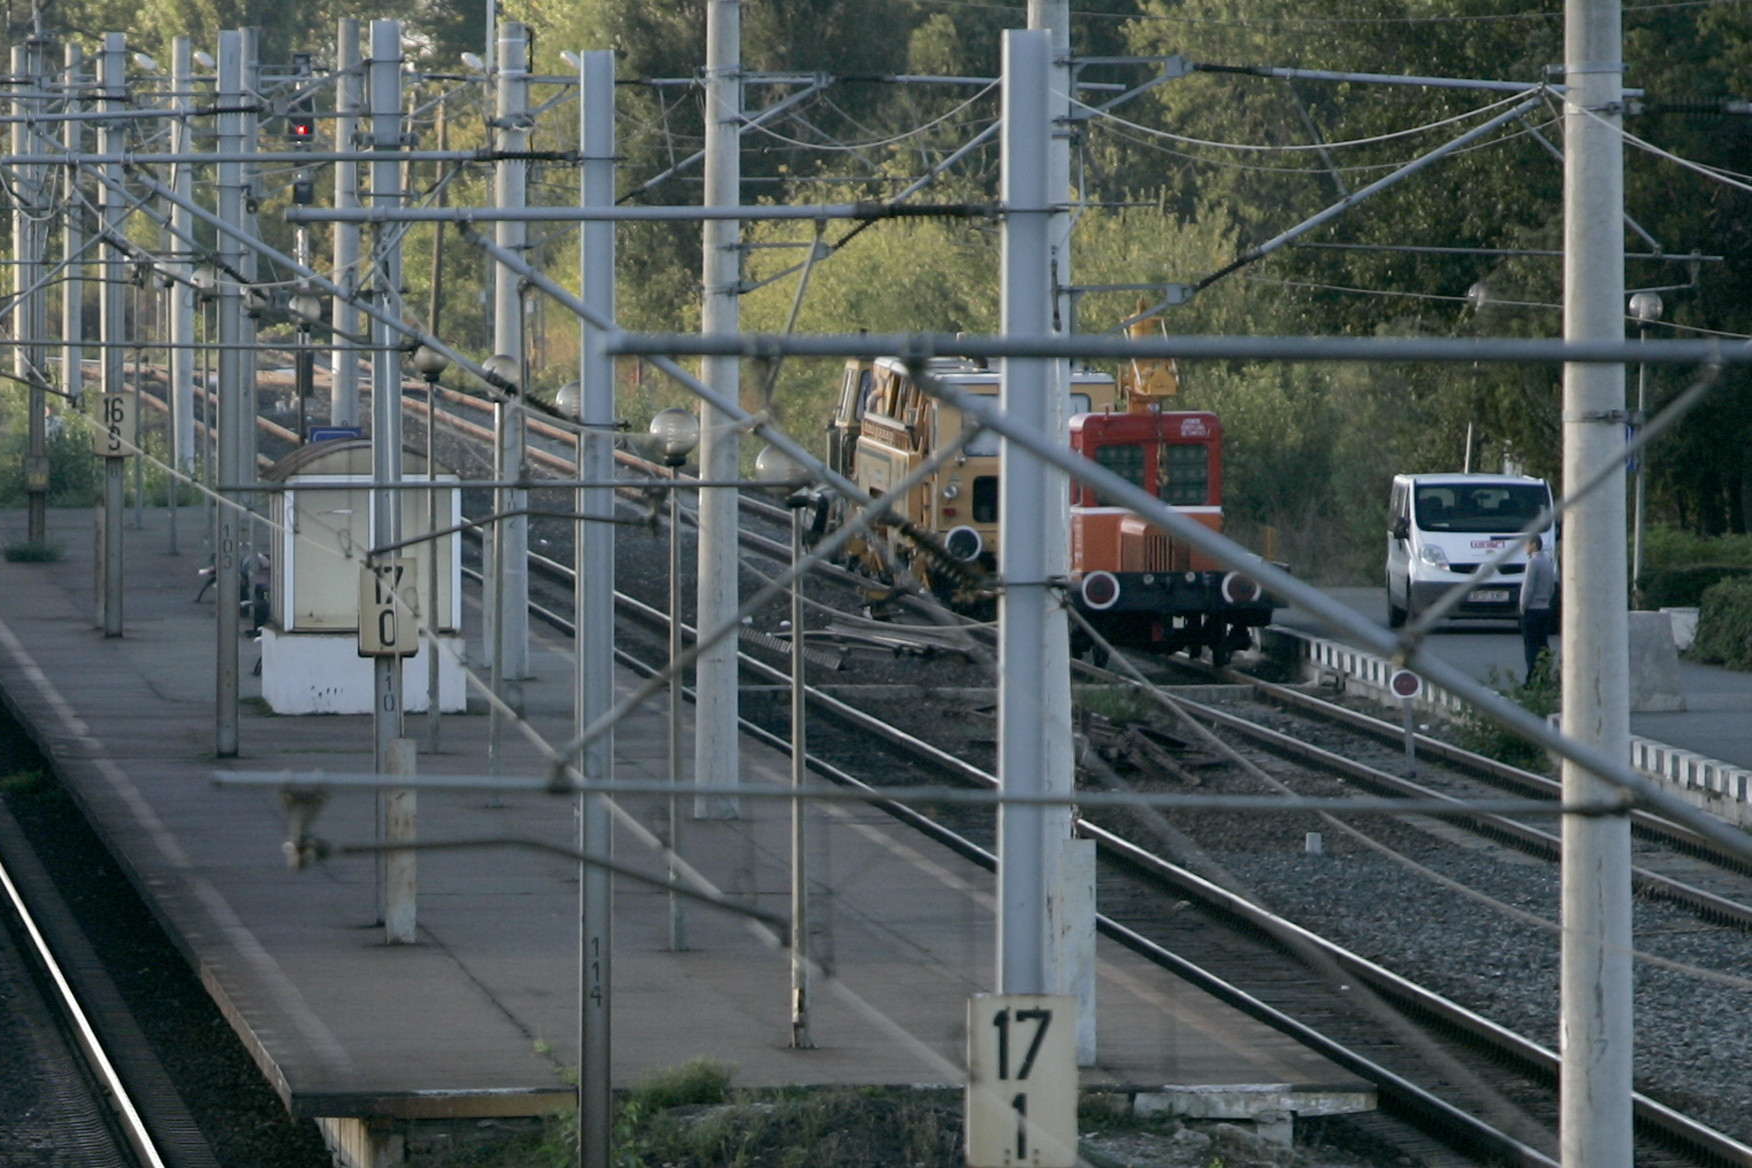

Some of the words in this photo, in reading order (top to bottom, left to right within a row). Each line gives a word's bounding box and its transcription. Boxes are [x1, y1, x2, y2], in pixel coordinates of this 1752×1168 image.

[103, 397, 124, 423] 16
[223, 524, 233, 569] 103
[375, 566, 403, 604] 17
[379, 609, 396, 646] 0
[590, 936, 602, 1008] 114
[993, 1009, 1052, 1080] 17
[1013, 1092, 1028, 1160] 1
